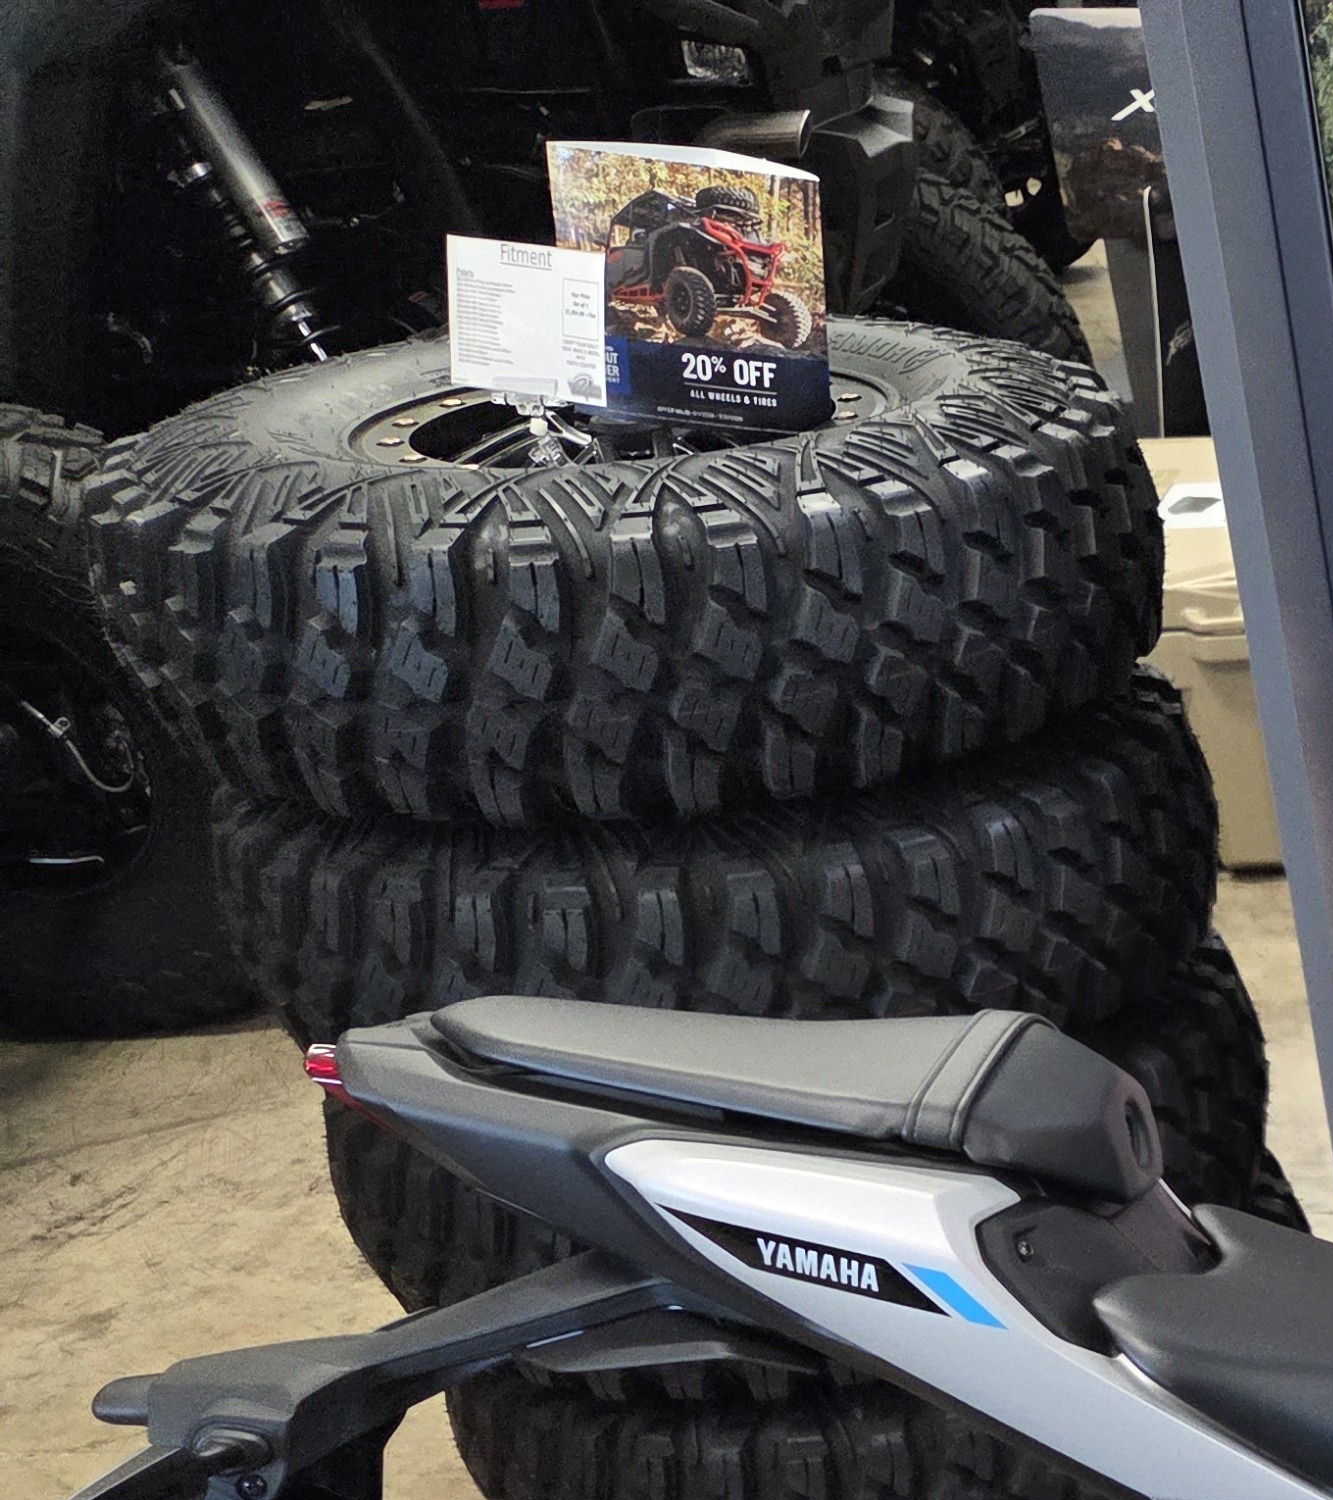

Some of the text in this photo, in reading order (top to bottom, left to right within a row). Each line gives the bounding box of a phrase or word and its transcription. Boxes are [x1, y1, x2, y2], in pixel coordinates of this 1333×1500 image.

[500, 243, 552, 267] Fitment
[681, 352, 777, 388] 20% OFF
[690, 389, 706, 400] ALL
[708, 391, 741, 404] WHEELS
[753, 395, 778, 408] TIRES
[756, 1237, 879, 1292] YAMAHA
